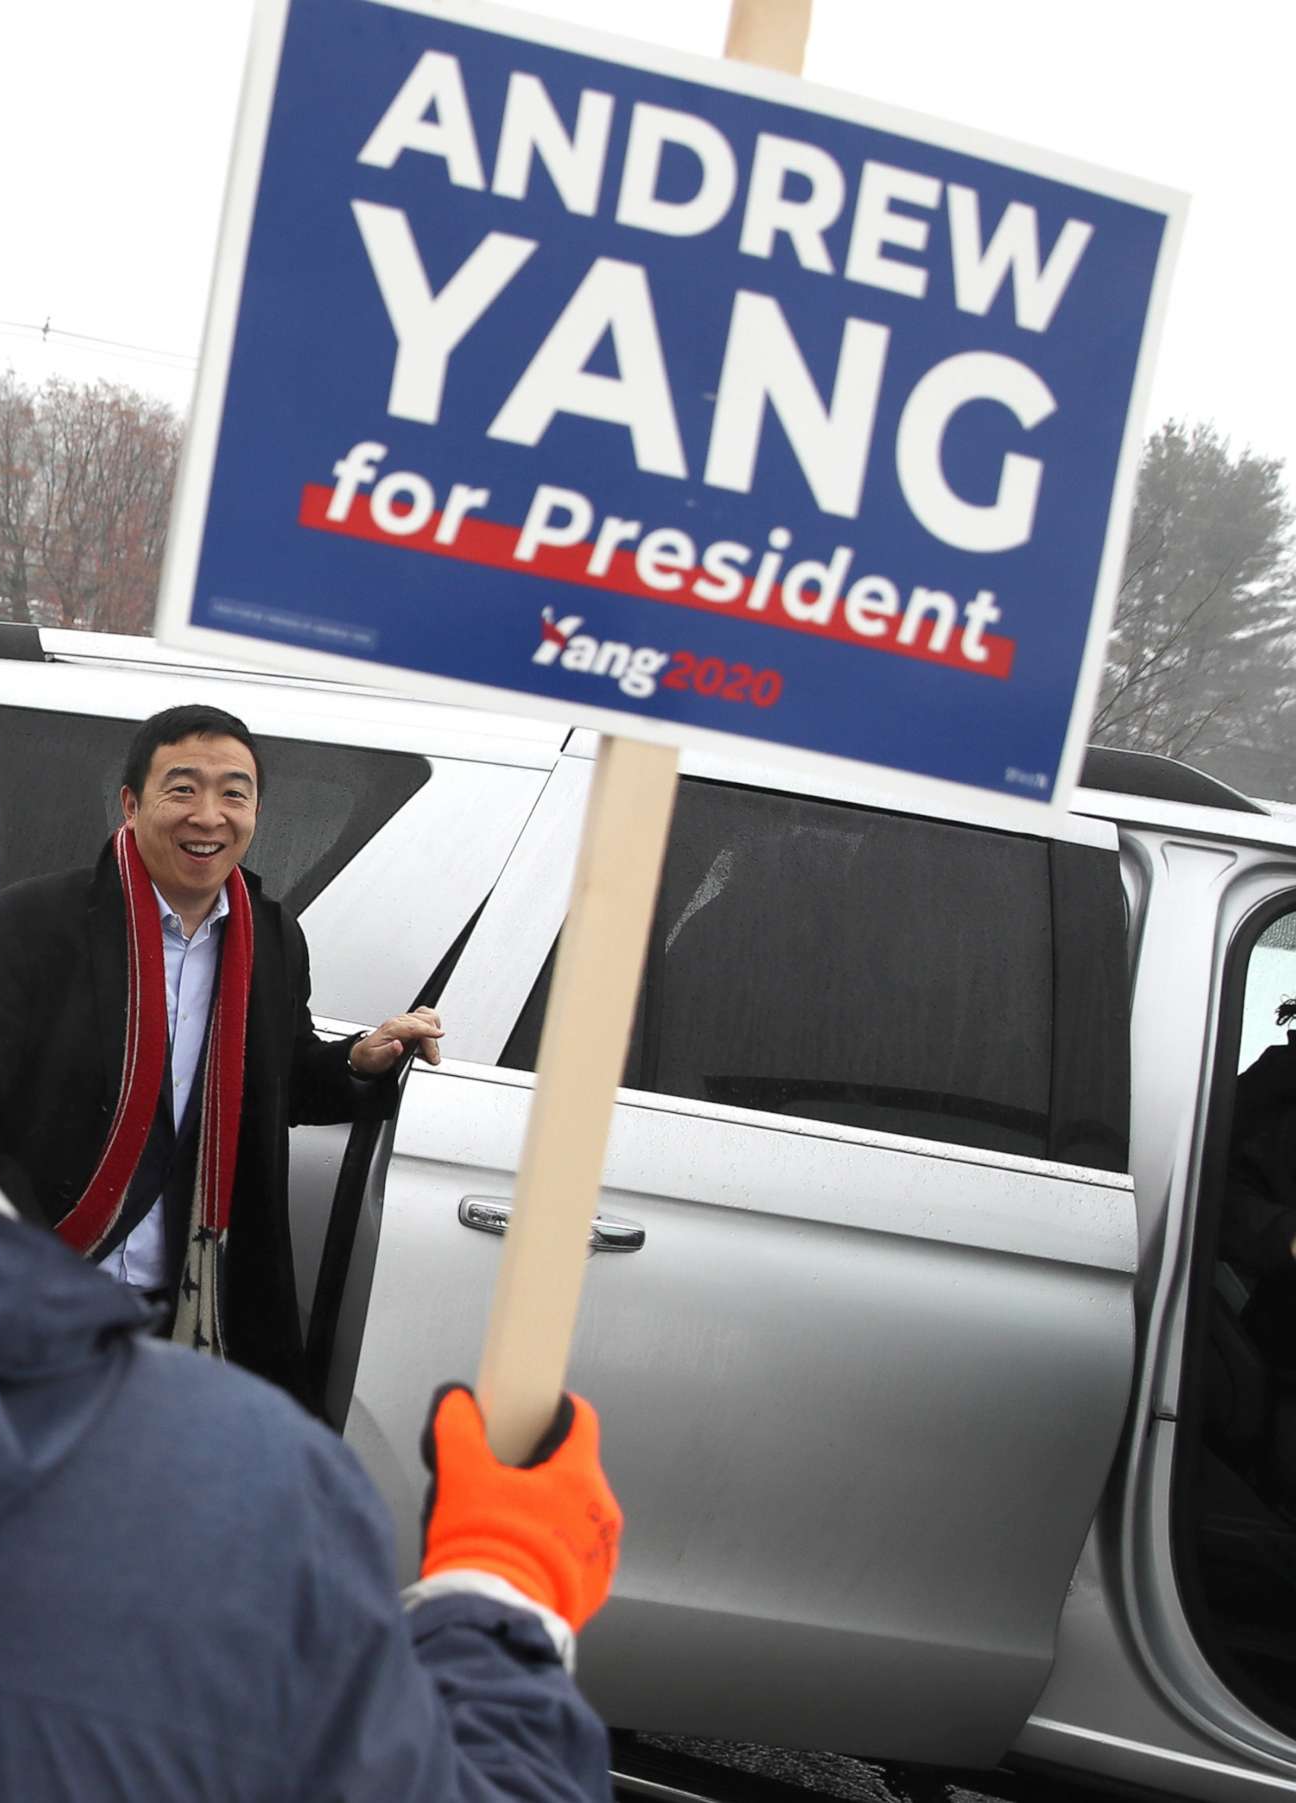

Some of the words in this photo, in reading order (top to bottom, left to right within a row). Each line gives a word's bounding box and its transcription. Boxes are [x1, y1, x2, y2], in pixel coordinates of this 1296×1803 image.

[358, 50, 1092, 332] ANDREW
[351, 201, 1056, 552] YANG
[325, 442, 487, 542] for
[515, 485, 998, 663] President
